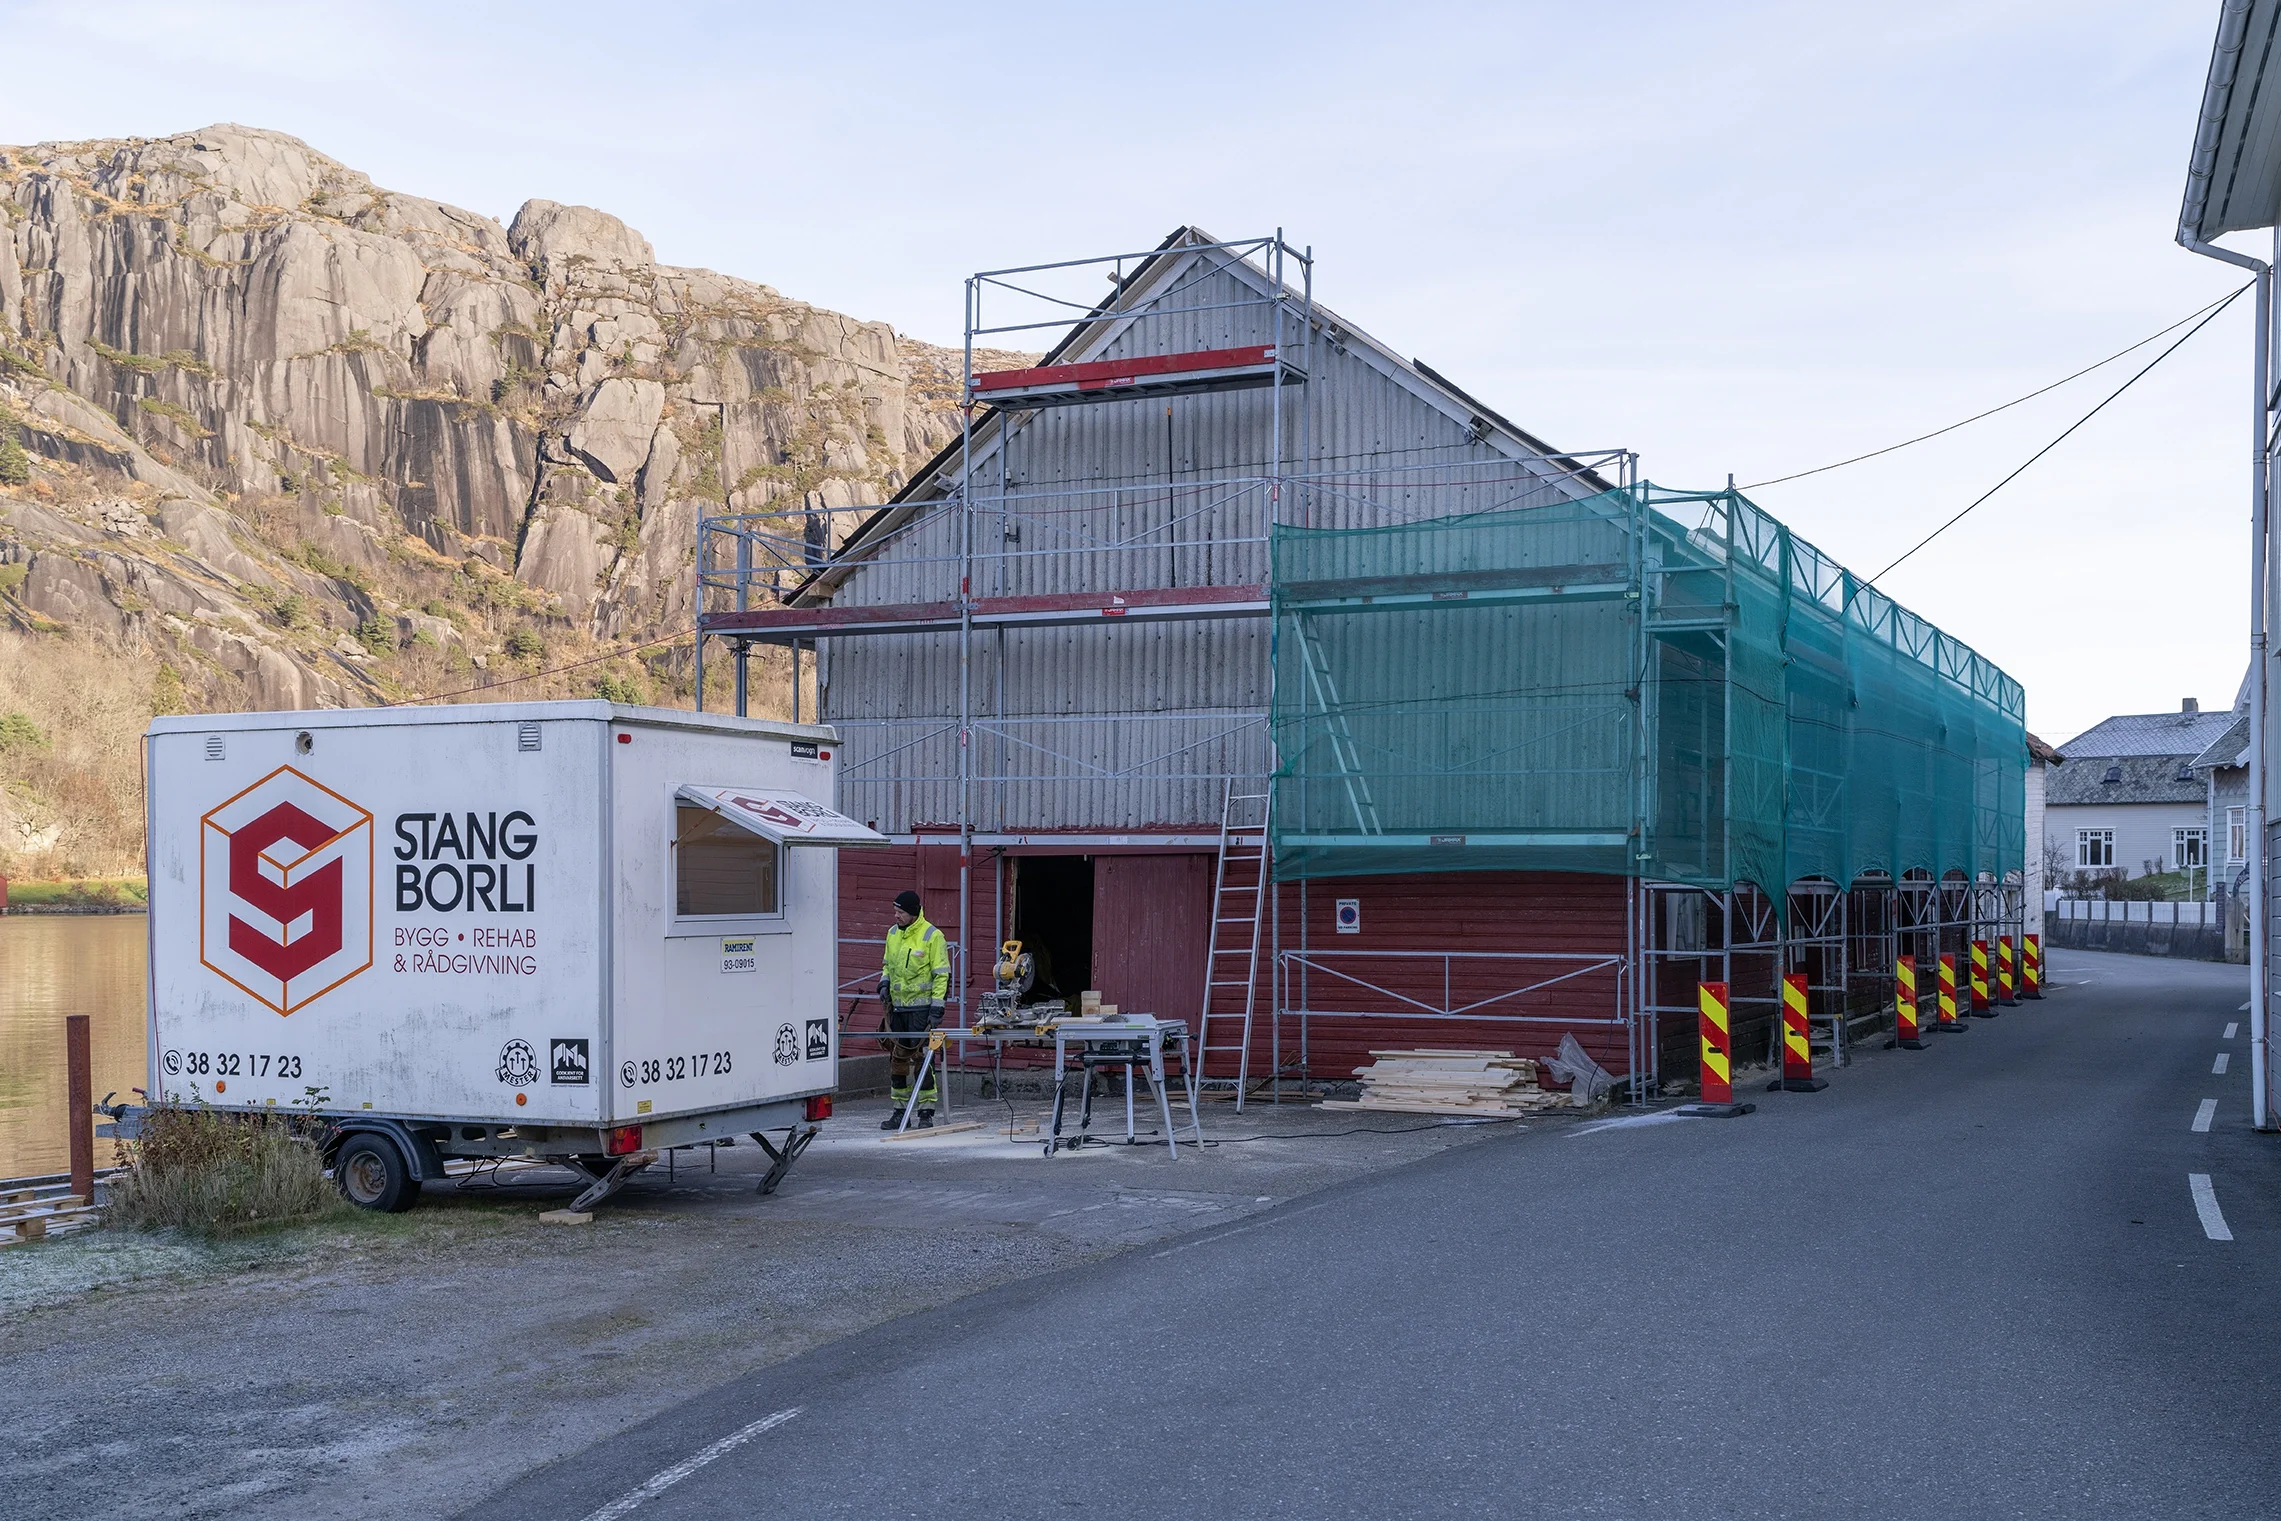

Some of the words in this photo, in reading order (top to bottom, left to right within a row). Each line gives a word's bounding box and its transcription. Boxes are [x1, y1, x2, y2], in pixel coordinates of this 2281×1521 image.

[393, 810, 538, 861] STANG
[396, 863, 535, 913] BORLI
[395, 927, 449, 947] BYGG
[473, 928, 537, 948] REHAB
[393, 953, 408, 973] &
[413, 949, 537, 975] RÅDGIVNING
[186, 1052, 210, 1075] 38
[216, 1053, 241, 1076] 32
[249, 1054, 271, 1077] 17
[277, 1055, 302, 1079] 23
[502, 1070, 534, 1085] MESTER
[641, 1059, 660, 1084] 38
[666, 1056, 685, 1081] 32
[692, 1054, 709, 1077] 17
[714, 1051, 732, 1075] 23
